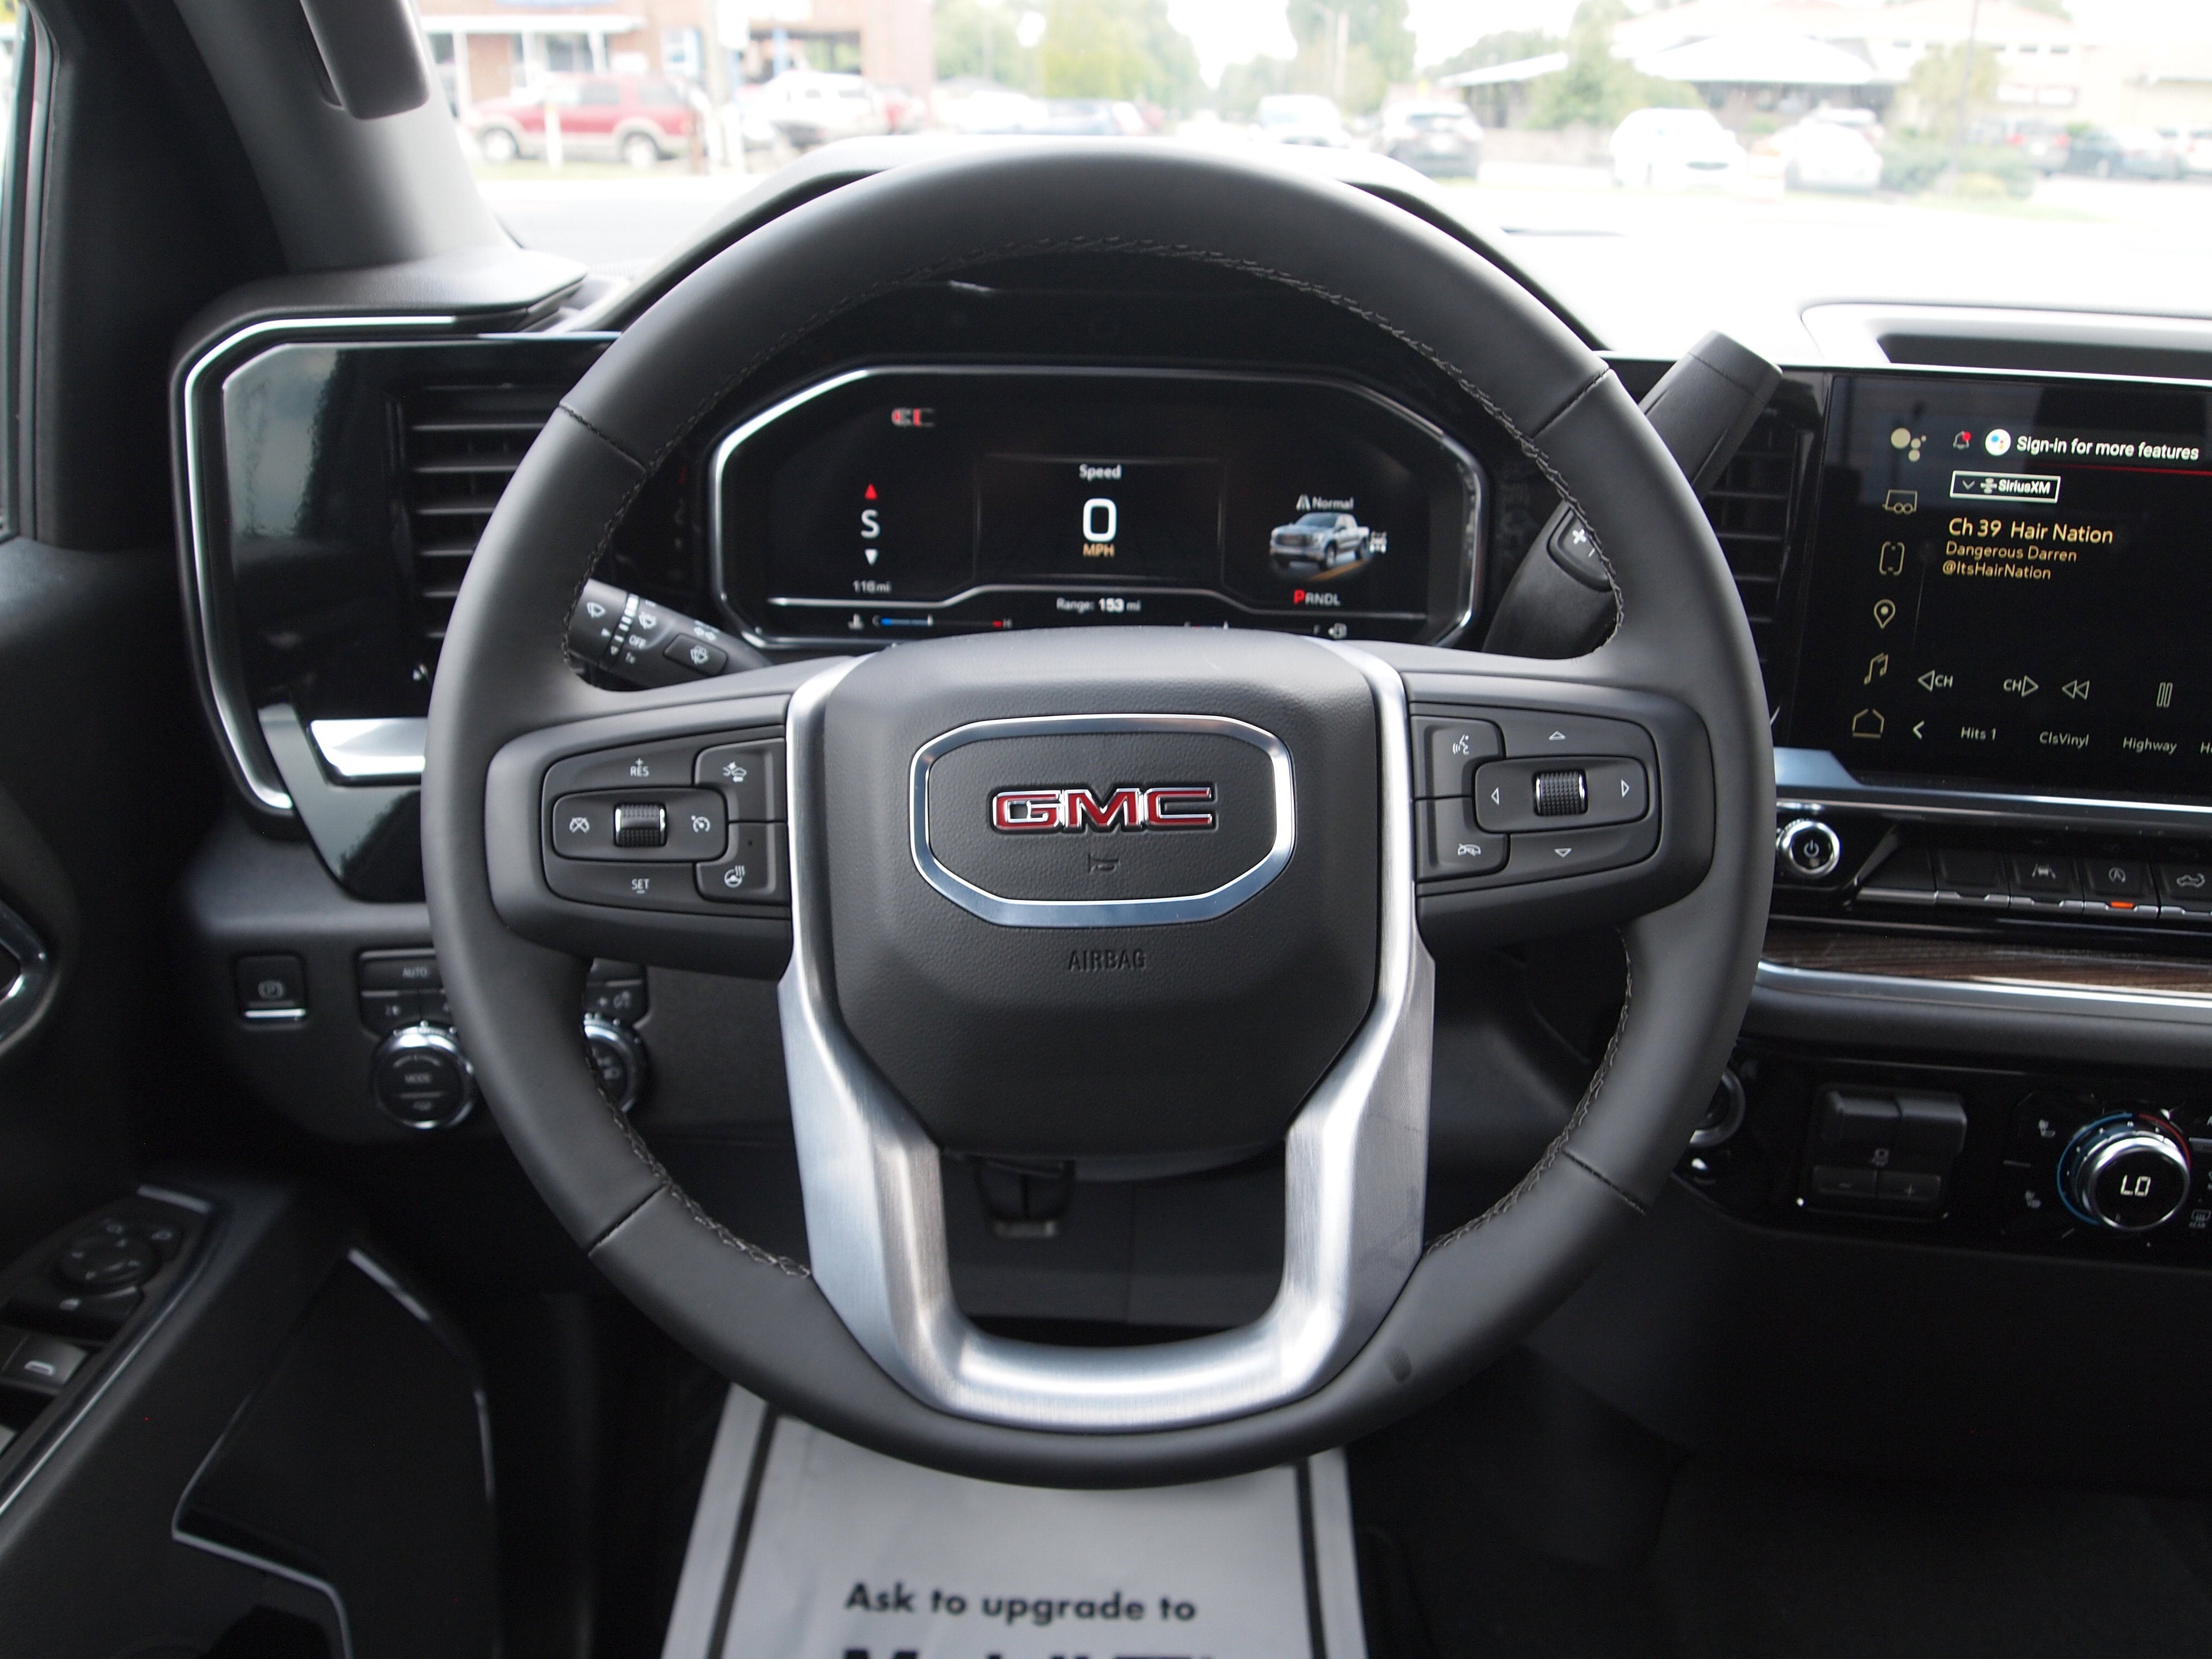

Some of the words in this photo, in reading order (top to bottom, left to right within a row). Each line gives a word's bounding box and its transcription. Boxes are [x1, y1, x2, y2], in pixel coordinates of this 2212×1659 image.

[2016, 436, 2067, 455] Sign-in
[2071, 438, 2094, 455] for
[2095, 443, 2135, 457] more
[2138, 441, 2199, 460] features
[1079, 464, 1122, 481] Speed
[1998, 478, 2051, 495] SiriusXM
[1312, 496, 1354, 510] Normal
[861, 509, 880, 538] S
[1082, 498, 1117, 542] 0
[1949, 517, 1973, 536] Ch
[1977, 519, 2002, 537] 39
[2011, 521, 2049, 540] Hair
[2052, 523, 2113, 544] Nation
[1083, 541, 1115, 556] MPH
[1946, 540, 2024, 560] Dangerous
[2028, 545, 2077, 562] Darren
[1942, 562, 2051, 579] @ItsHairNation
[876, 580, 892, 594] mi
[1056, 597, 1093, 613] Range:
[1099, 597, 1125, 612] 153
[1126, 600, 1142, 611] mi
[629, 635, 647, 649] OFF
[1934, 675, 1953, 687] CH
[2003, 679, 2022, 692] CH
[1961, 726, 1986, 740] Hits
[1992, 728, 1996, 740] 1
[2039, 731, 2089, 749] ClsVinyl
[2123, 737, 2177, 755] Highway
[2200, 742, 2212, 754] H
[630, 765, 649, 777] RES
[992, 787, 1213, 830] GMC
[631, 878, 649, 890] SET
[1068, 950, 1146, 971] AIRBAG
[402, 966, 428, 978] AUTO
[845, 1583, 913, 1612] Ask
[930, 1590, 968, 1616] to
[981, 1592, 1145, 1627] upgrade
[1159, 1598, 1197, 1621] to
